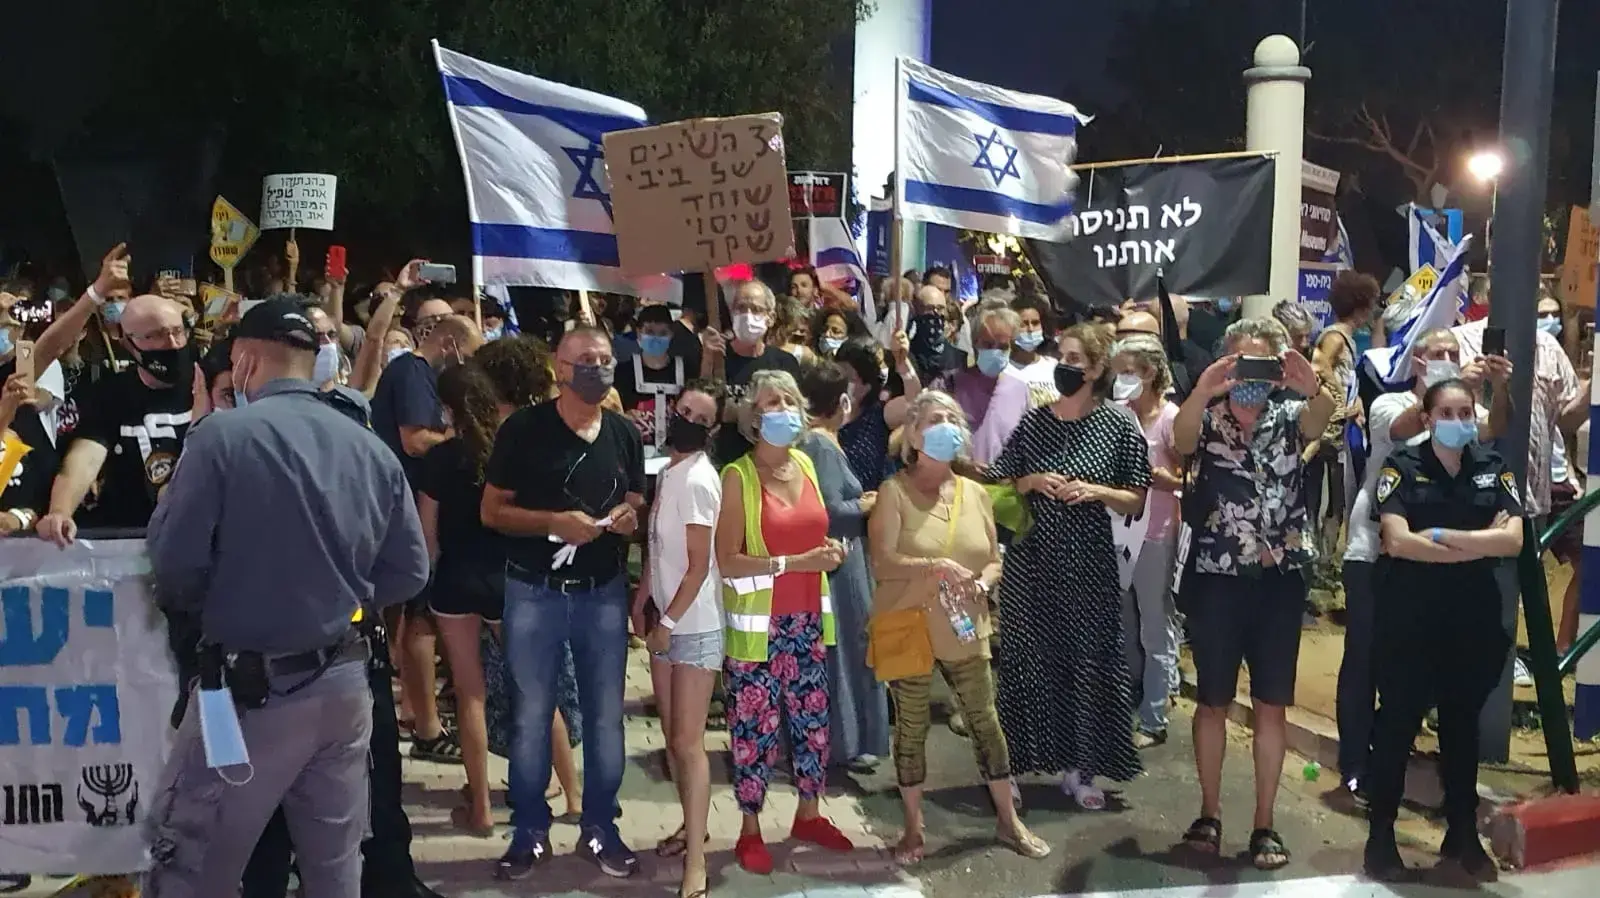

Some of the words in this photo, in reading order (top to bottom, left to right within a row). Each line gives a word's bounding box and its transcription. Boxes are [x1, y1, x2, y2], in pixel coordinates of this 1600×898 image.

[749, 124, 769, 157] 3
[626, 166, 692, 190] ביבי
[711, 160, 755, 185] של
[266, 185, 294, 200] טפיל
[302, 188, 327, 198] אתה
[681, 184, 773, 212] שוחד
[307, 211, 324, 220] את
[686, 208, 771, 235] שיסוי
[1161, 196, 1202, 229] לא
[696, 231, 774, 262] שקר
[1093, 239, 1176, 268] אותנו
